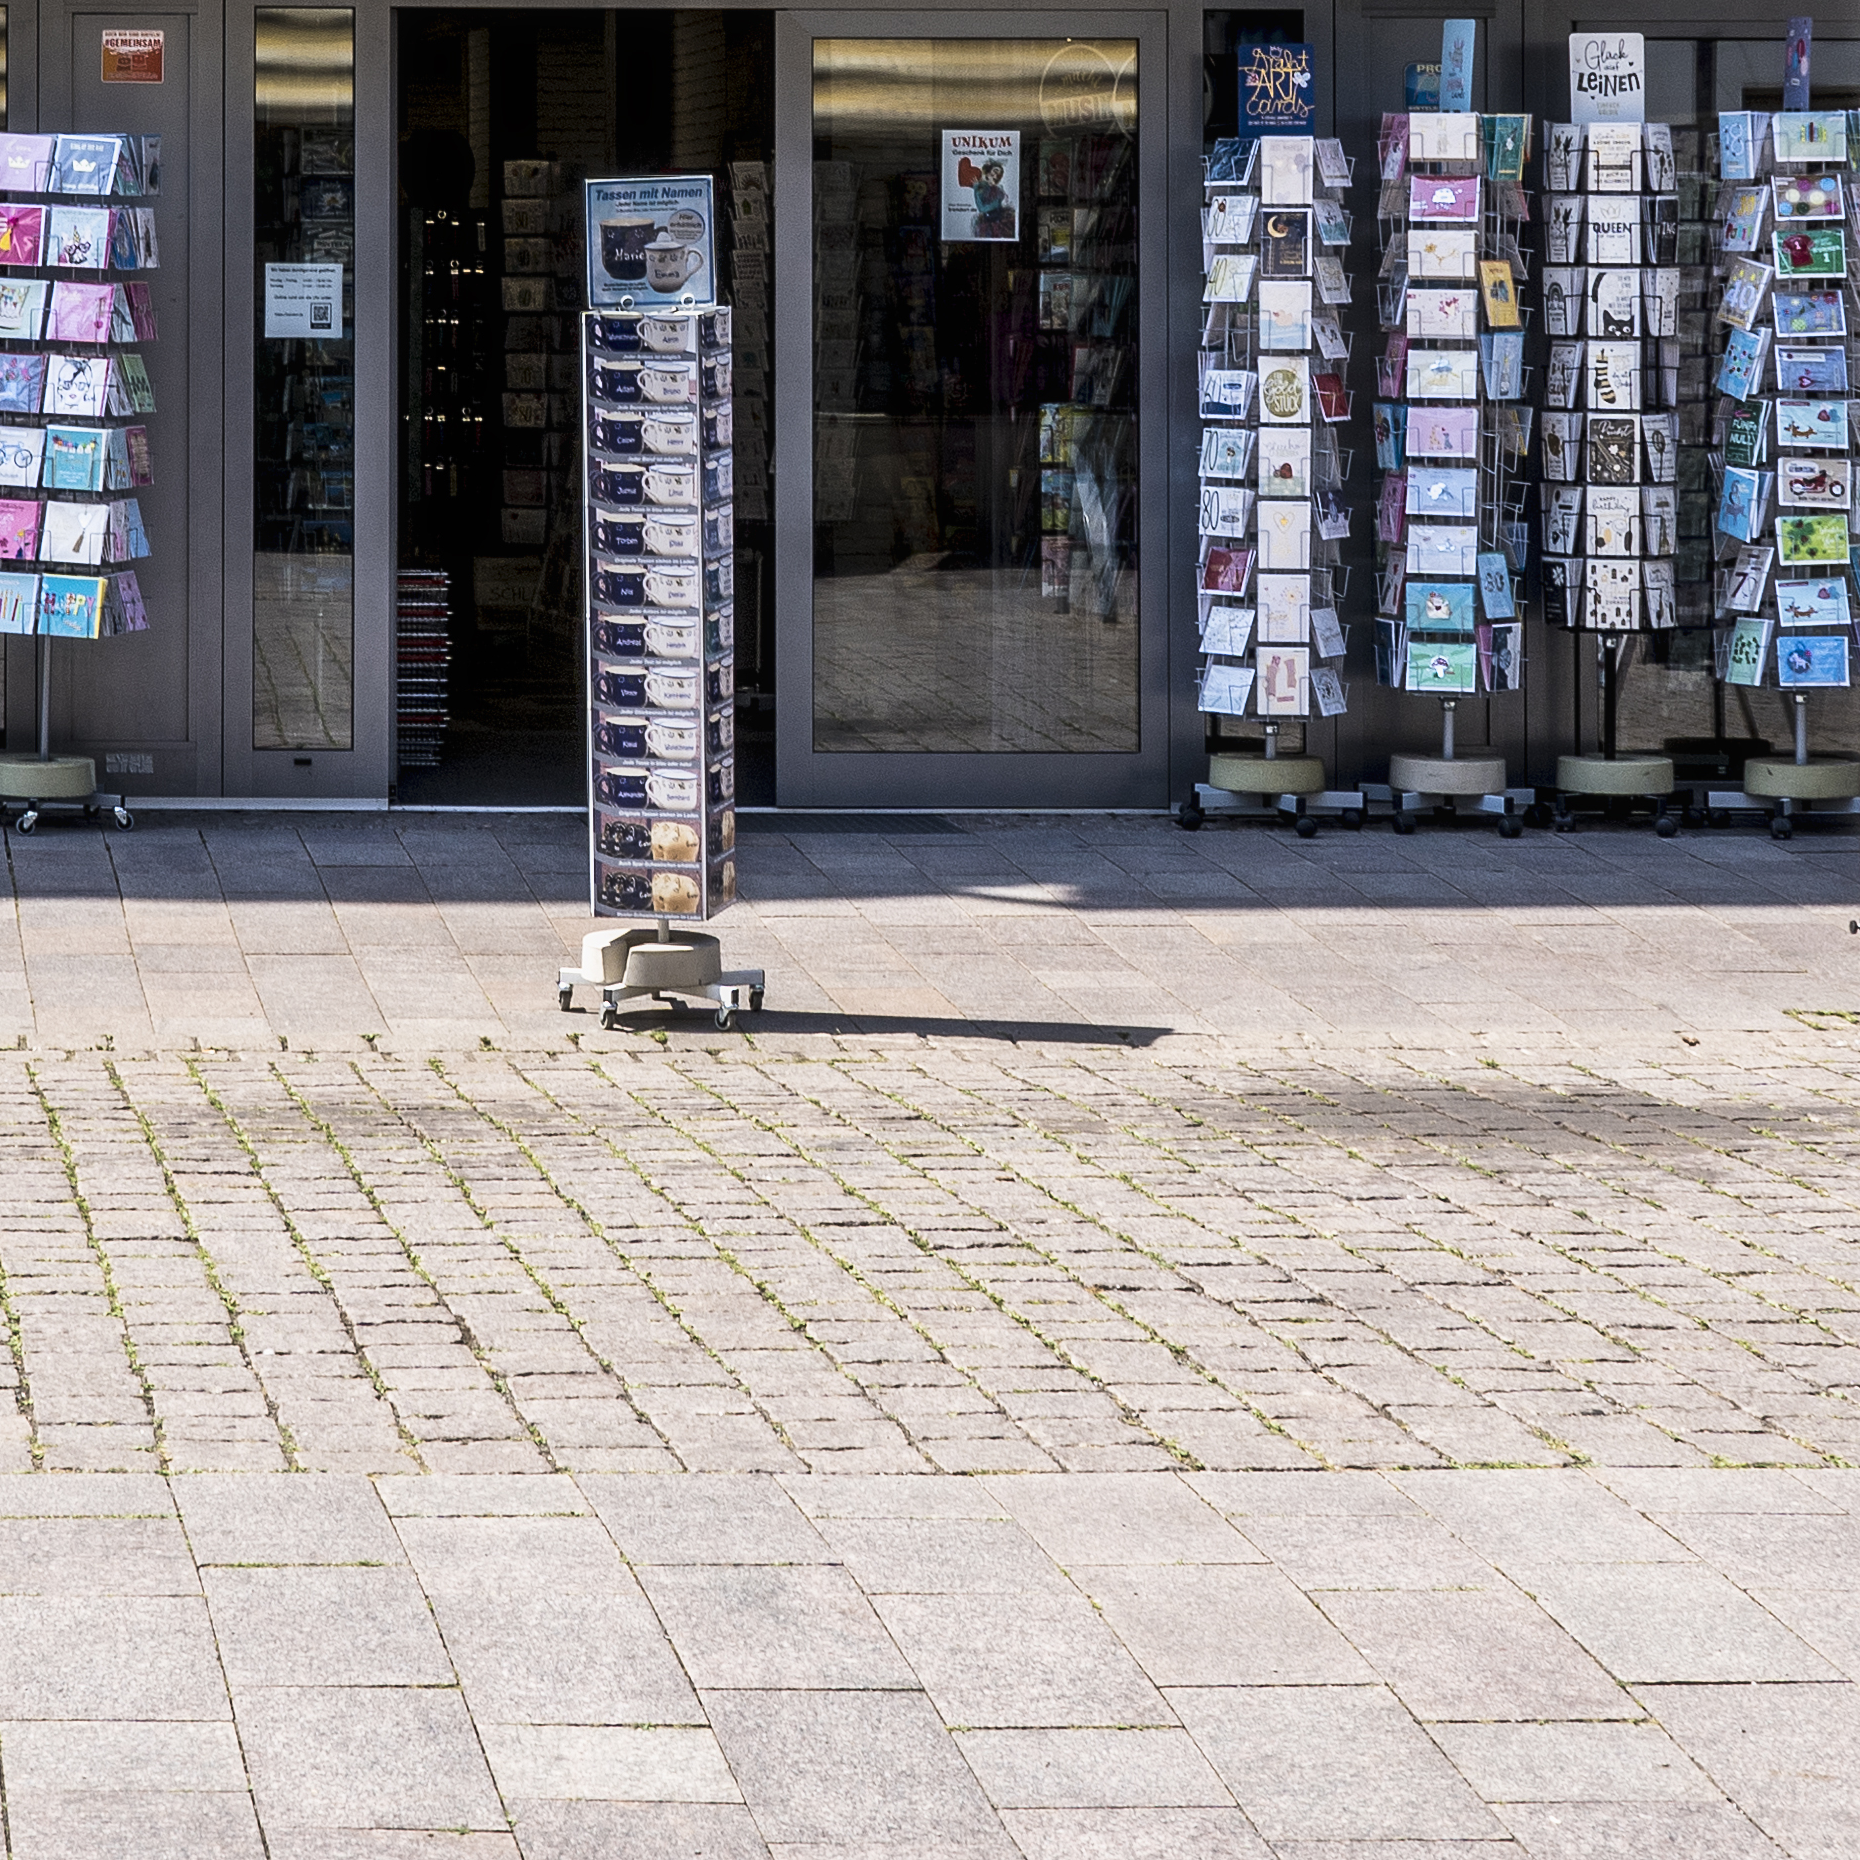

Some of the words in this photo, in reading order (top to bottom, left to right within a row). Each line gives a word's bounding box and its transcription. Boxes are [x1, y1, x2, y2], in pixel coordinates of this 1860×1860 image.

[951, 135, 1012, 149] UNIKUM
[595, 188, 637, 201] Tassen
[640, 187, 658, 199] mit
[661, 186, 703, 198] Namen
[1592, 222, 1632, 234] QUEEN
[615, 248, 646, 261] Marie
[654, 269, 680, 279] Emma
